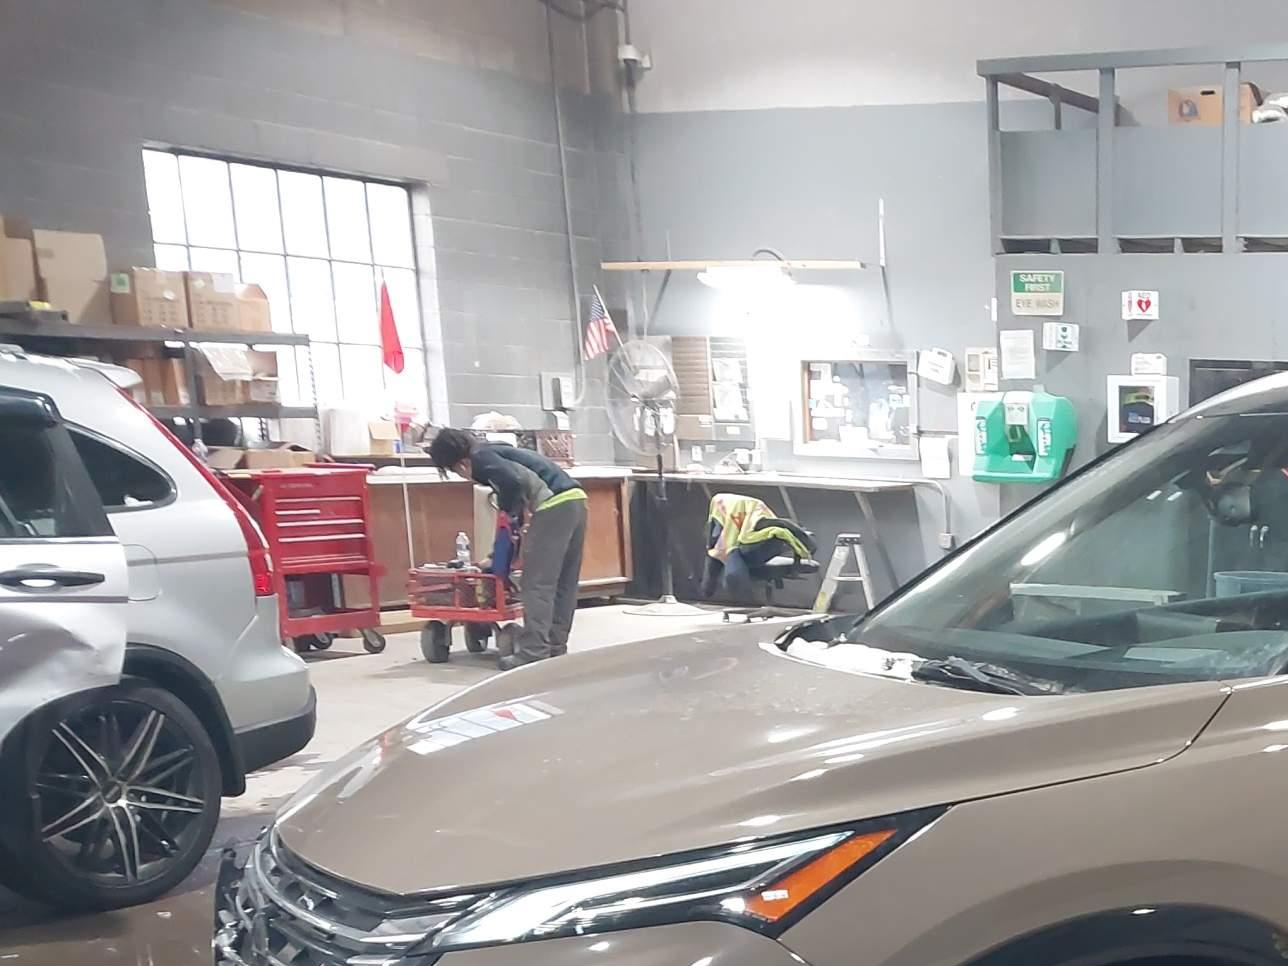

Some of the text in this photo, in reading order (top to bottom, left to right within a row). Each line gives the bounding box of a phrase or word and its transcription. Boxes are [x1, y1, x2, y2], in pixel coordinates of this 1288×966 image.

[1019, 274, 1056, 282] SAFETY
[1025, 283, 1050, 292] FIRST
[1015, 299, 1032, 308] EYE
